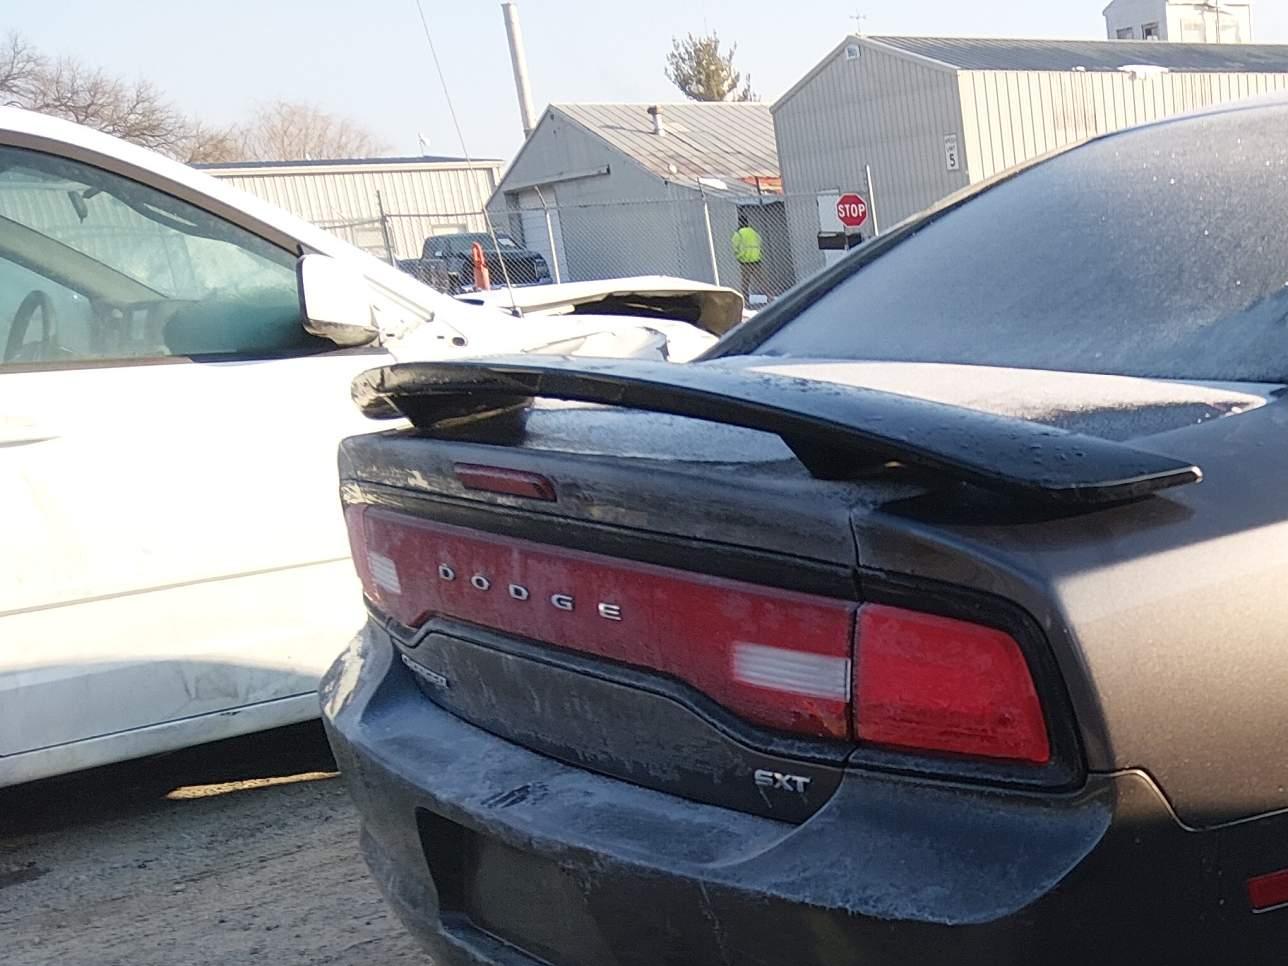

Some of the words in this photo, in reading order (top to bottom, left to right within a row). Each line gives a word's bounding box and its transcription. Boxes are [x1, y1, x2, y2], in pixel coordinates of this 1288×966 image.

[949, 153, 956, 167] 5
[838, 204, 866, 218] STOP
[438, 563, 622, 621] DODGE
[754, 769, 811, 793] SXT
